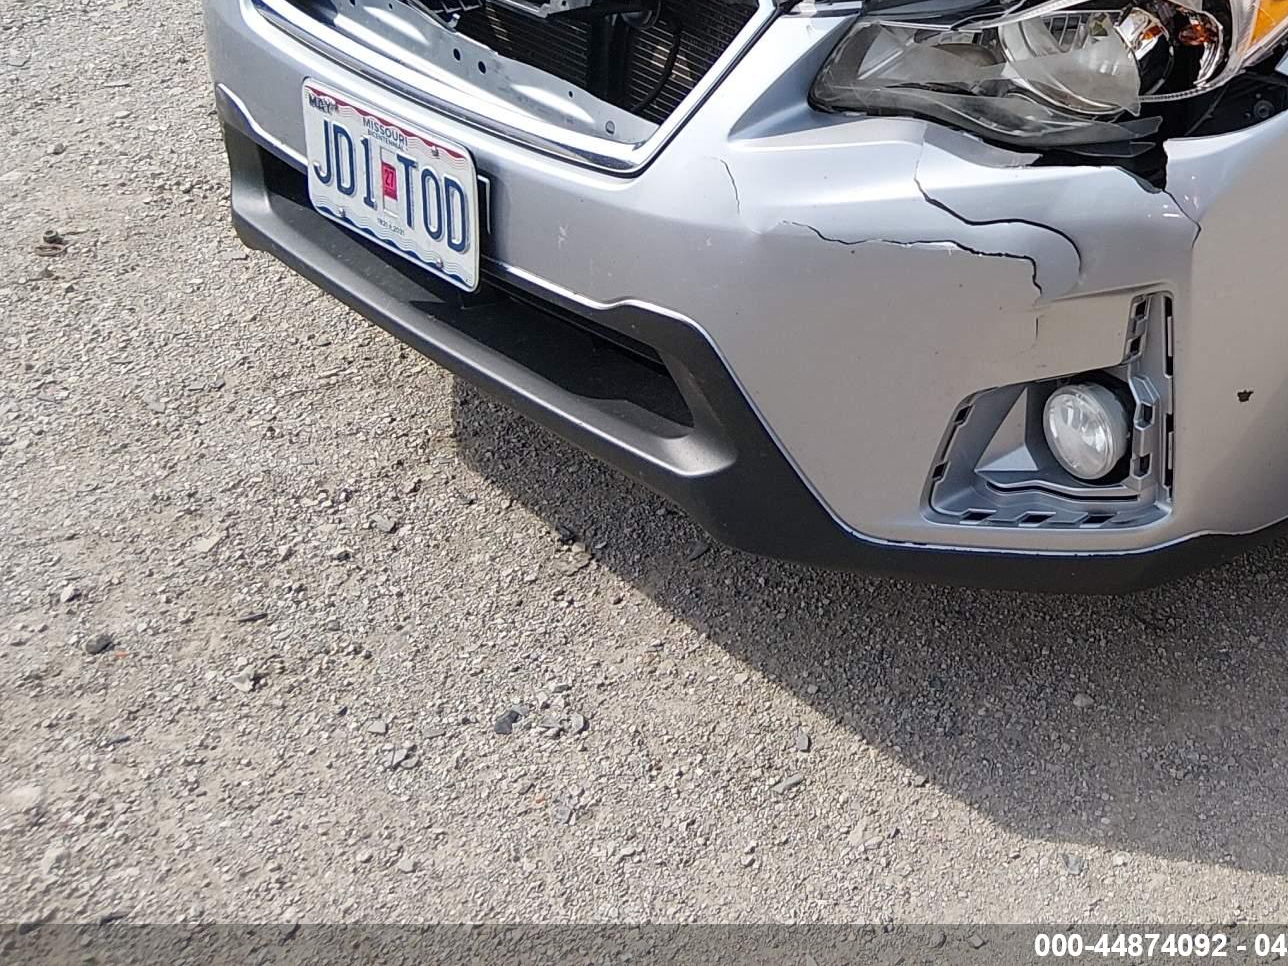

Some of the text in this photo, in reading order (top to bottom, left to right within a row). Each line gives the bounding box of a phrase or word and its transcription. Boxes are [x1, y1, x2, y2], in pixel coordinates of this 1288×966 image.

[362, 116, 408, 147] MISSOURI
[313, 119, 377, 211] JD1
[384, 168, 394, 188] 27
